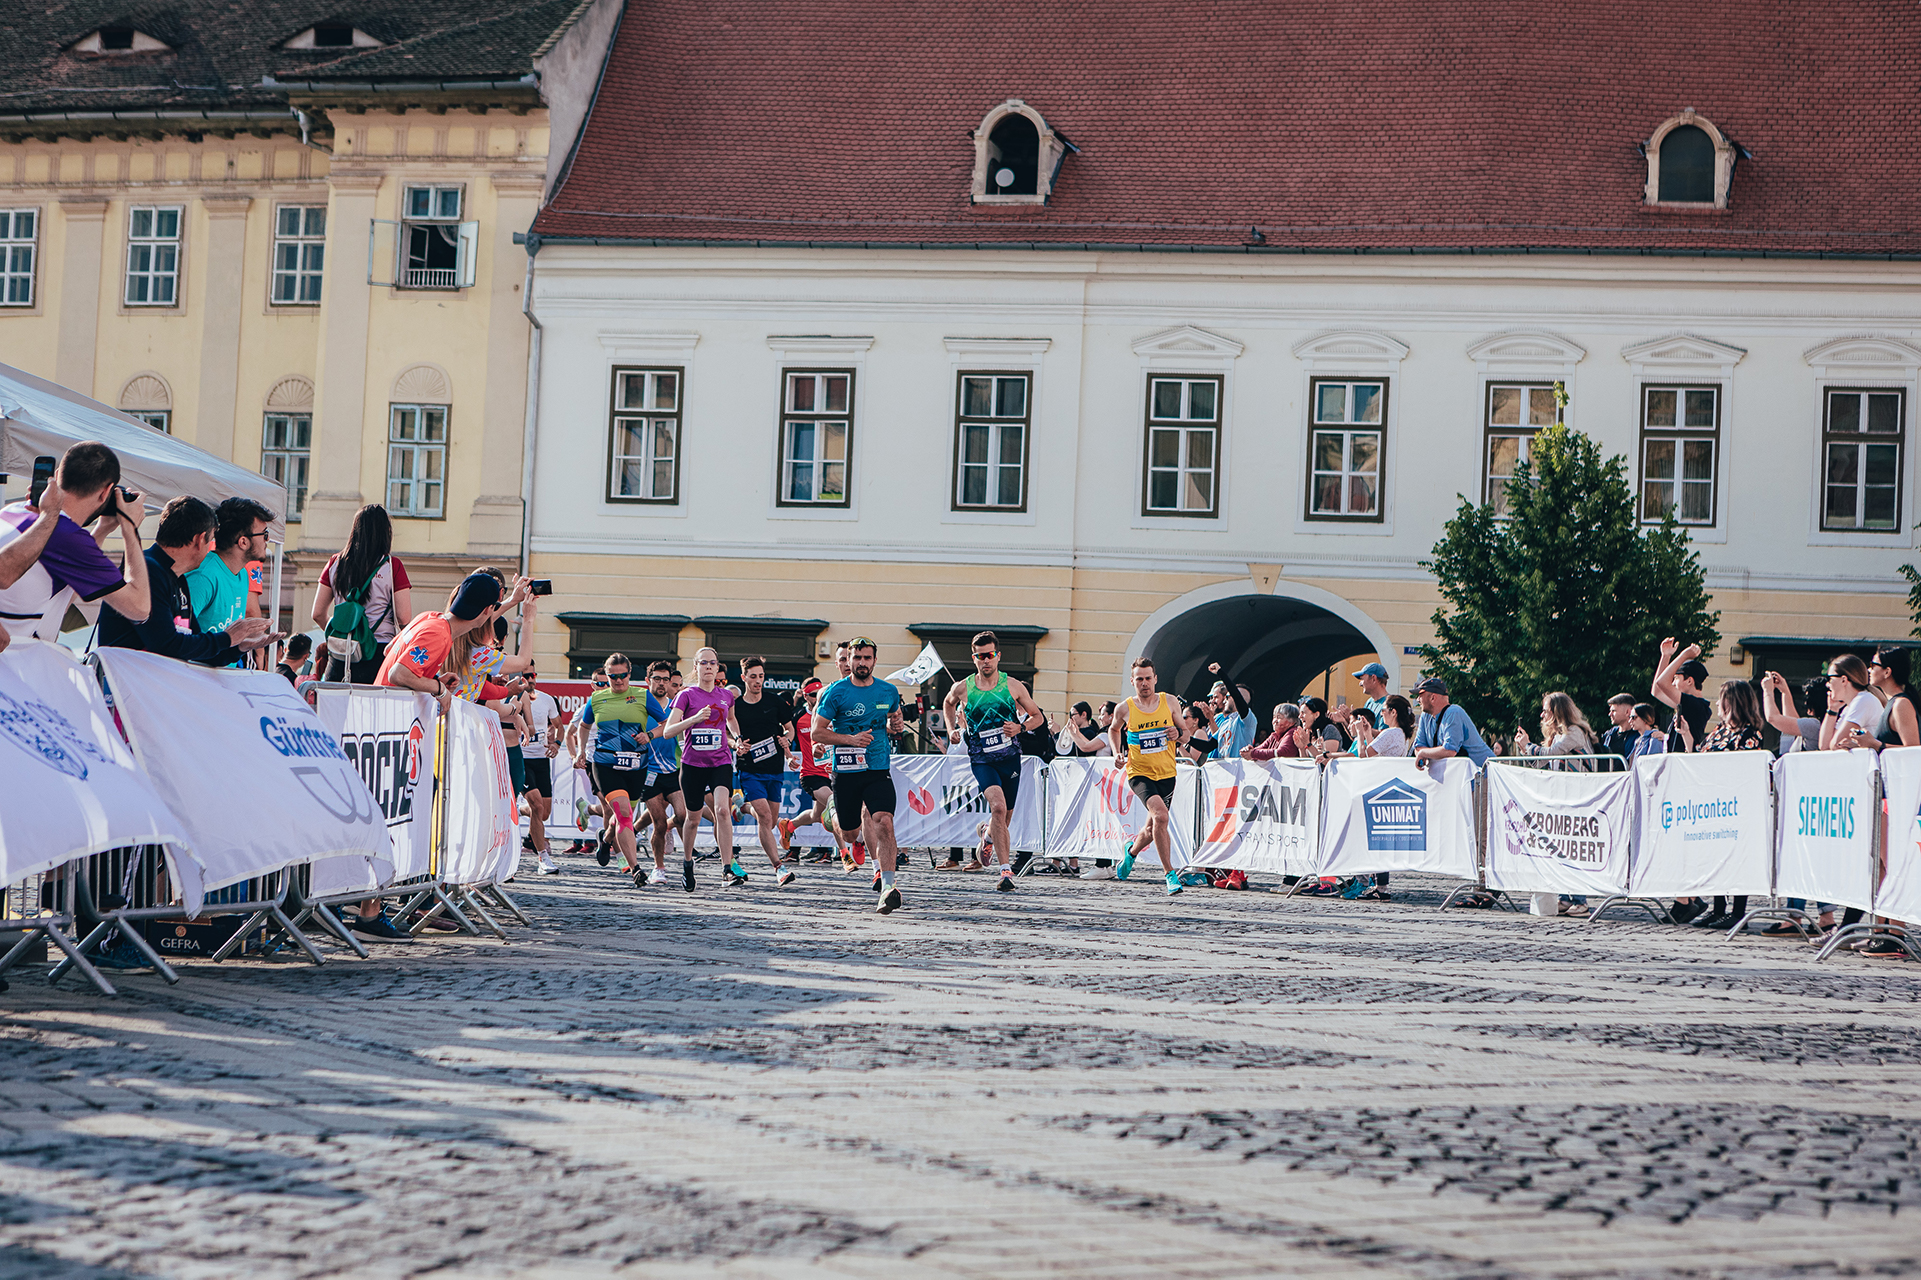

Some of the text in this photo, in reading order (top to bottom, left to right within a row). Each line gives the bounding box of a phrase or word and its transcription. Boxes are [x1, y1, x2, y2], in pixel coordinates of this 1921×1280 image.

[1263, 576, 1269, 585] 7
[1138, 720, 1159, 730] WEST
[695, 735, 709, 744] 215
[985, 735, 999, 746] 466
[1143, 739, 1157, 748] 345
[617, 757, 630, 766] 214
[839, 755, 853, 764] 258
[553, 798, 571, 806] ARK
[942, 785, 992, 815] VISM
[1240, 784, 1307, 827] SAM
[1371, 805, 1421, 823] UNIMAT
[1676, 796, 1738, 826] polycontact
[1798, 795, 1855, 840] SIEMENS
[1523, 811, 1599, 838] KROMBERG
[1237, 831, 1306, 848] TRANSPORT
[160, 937, 201, 950] GEFRA
